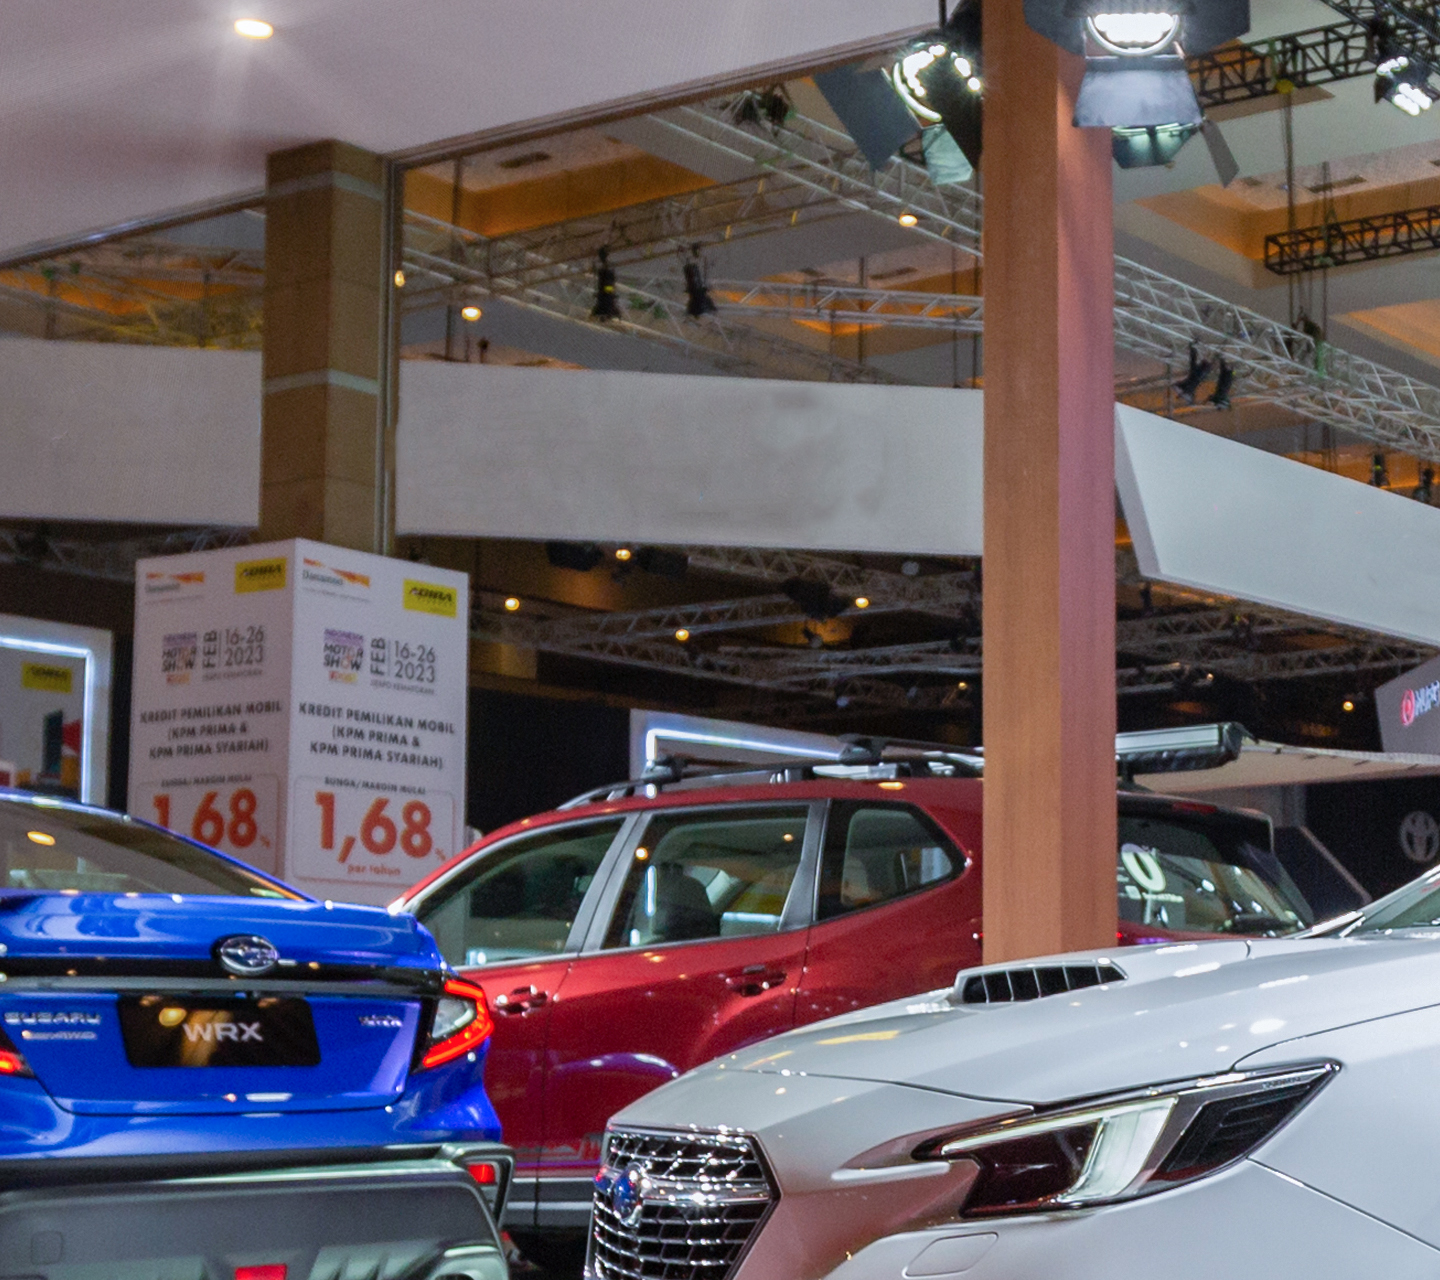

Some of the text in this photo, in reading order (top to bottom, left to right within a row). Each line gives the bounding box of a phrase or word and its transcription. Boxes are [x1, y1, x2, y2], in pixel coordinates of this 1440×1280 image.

[225, 625, 264, 646] 16-26
[203, 630, 217, 668] FEB
[225, 645, 263, 666] 2023
[370, 637, 385, 676] FEB
[394, 641, 436, 664] 16-26
[394, 661, 436, 683] 2023
[140, 700, 282, 723] KREDIT PEMILIKAN MOBIL
[299, 702, 455, 734] KREDIT PEMILIKAN MOBIL
[200, 724, 235, 736] PRIMA
[332, 725, 420, 748] (KPM PRIMA &
[149, 746, 173, 758] KPM
[177, 743, 212, 757] PRIMA
[310, 741, 443, 770] KPM PRIMA SYARIAH)
[4, 1012, 101, 1025] SUBARU
[182, 1022, 263, 1042] WRX
